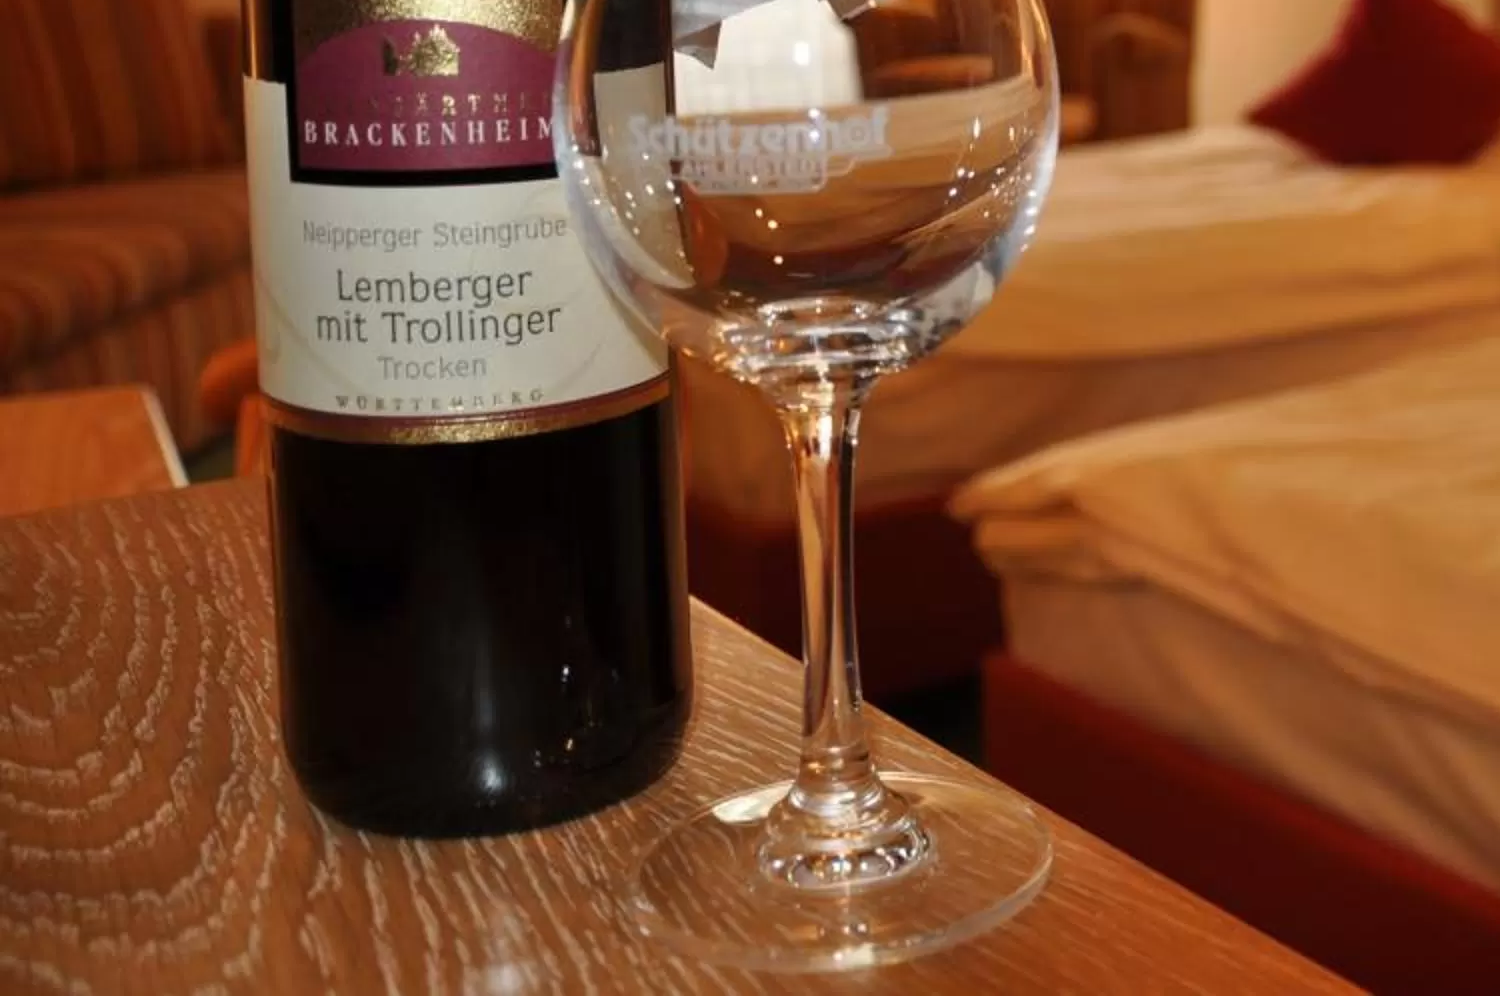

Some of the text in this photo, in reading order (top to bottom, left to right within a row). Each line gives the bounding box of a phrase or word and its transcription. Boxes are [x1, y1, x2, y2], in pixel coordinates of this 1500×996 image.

[303, 116, 553, 147] BRACKENHEIM
[302, 216, 568, 253] Neipperger Steingrube
[337, 268, 533, 308] Lemberger
[316, 306, 561, 346] mit Trollinger
[377, 354, 487, 381] Trocken
